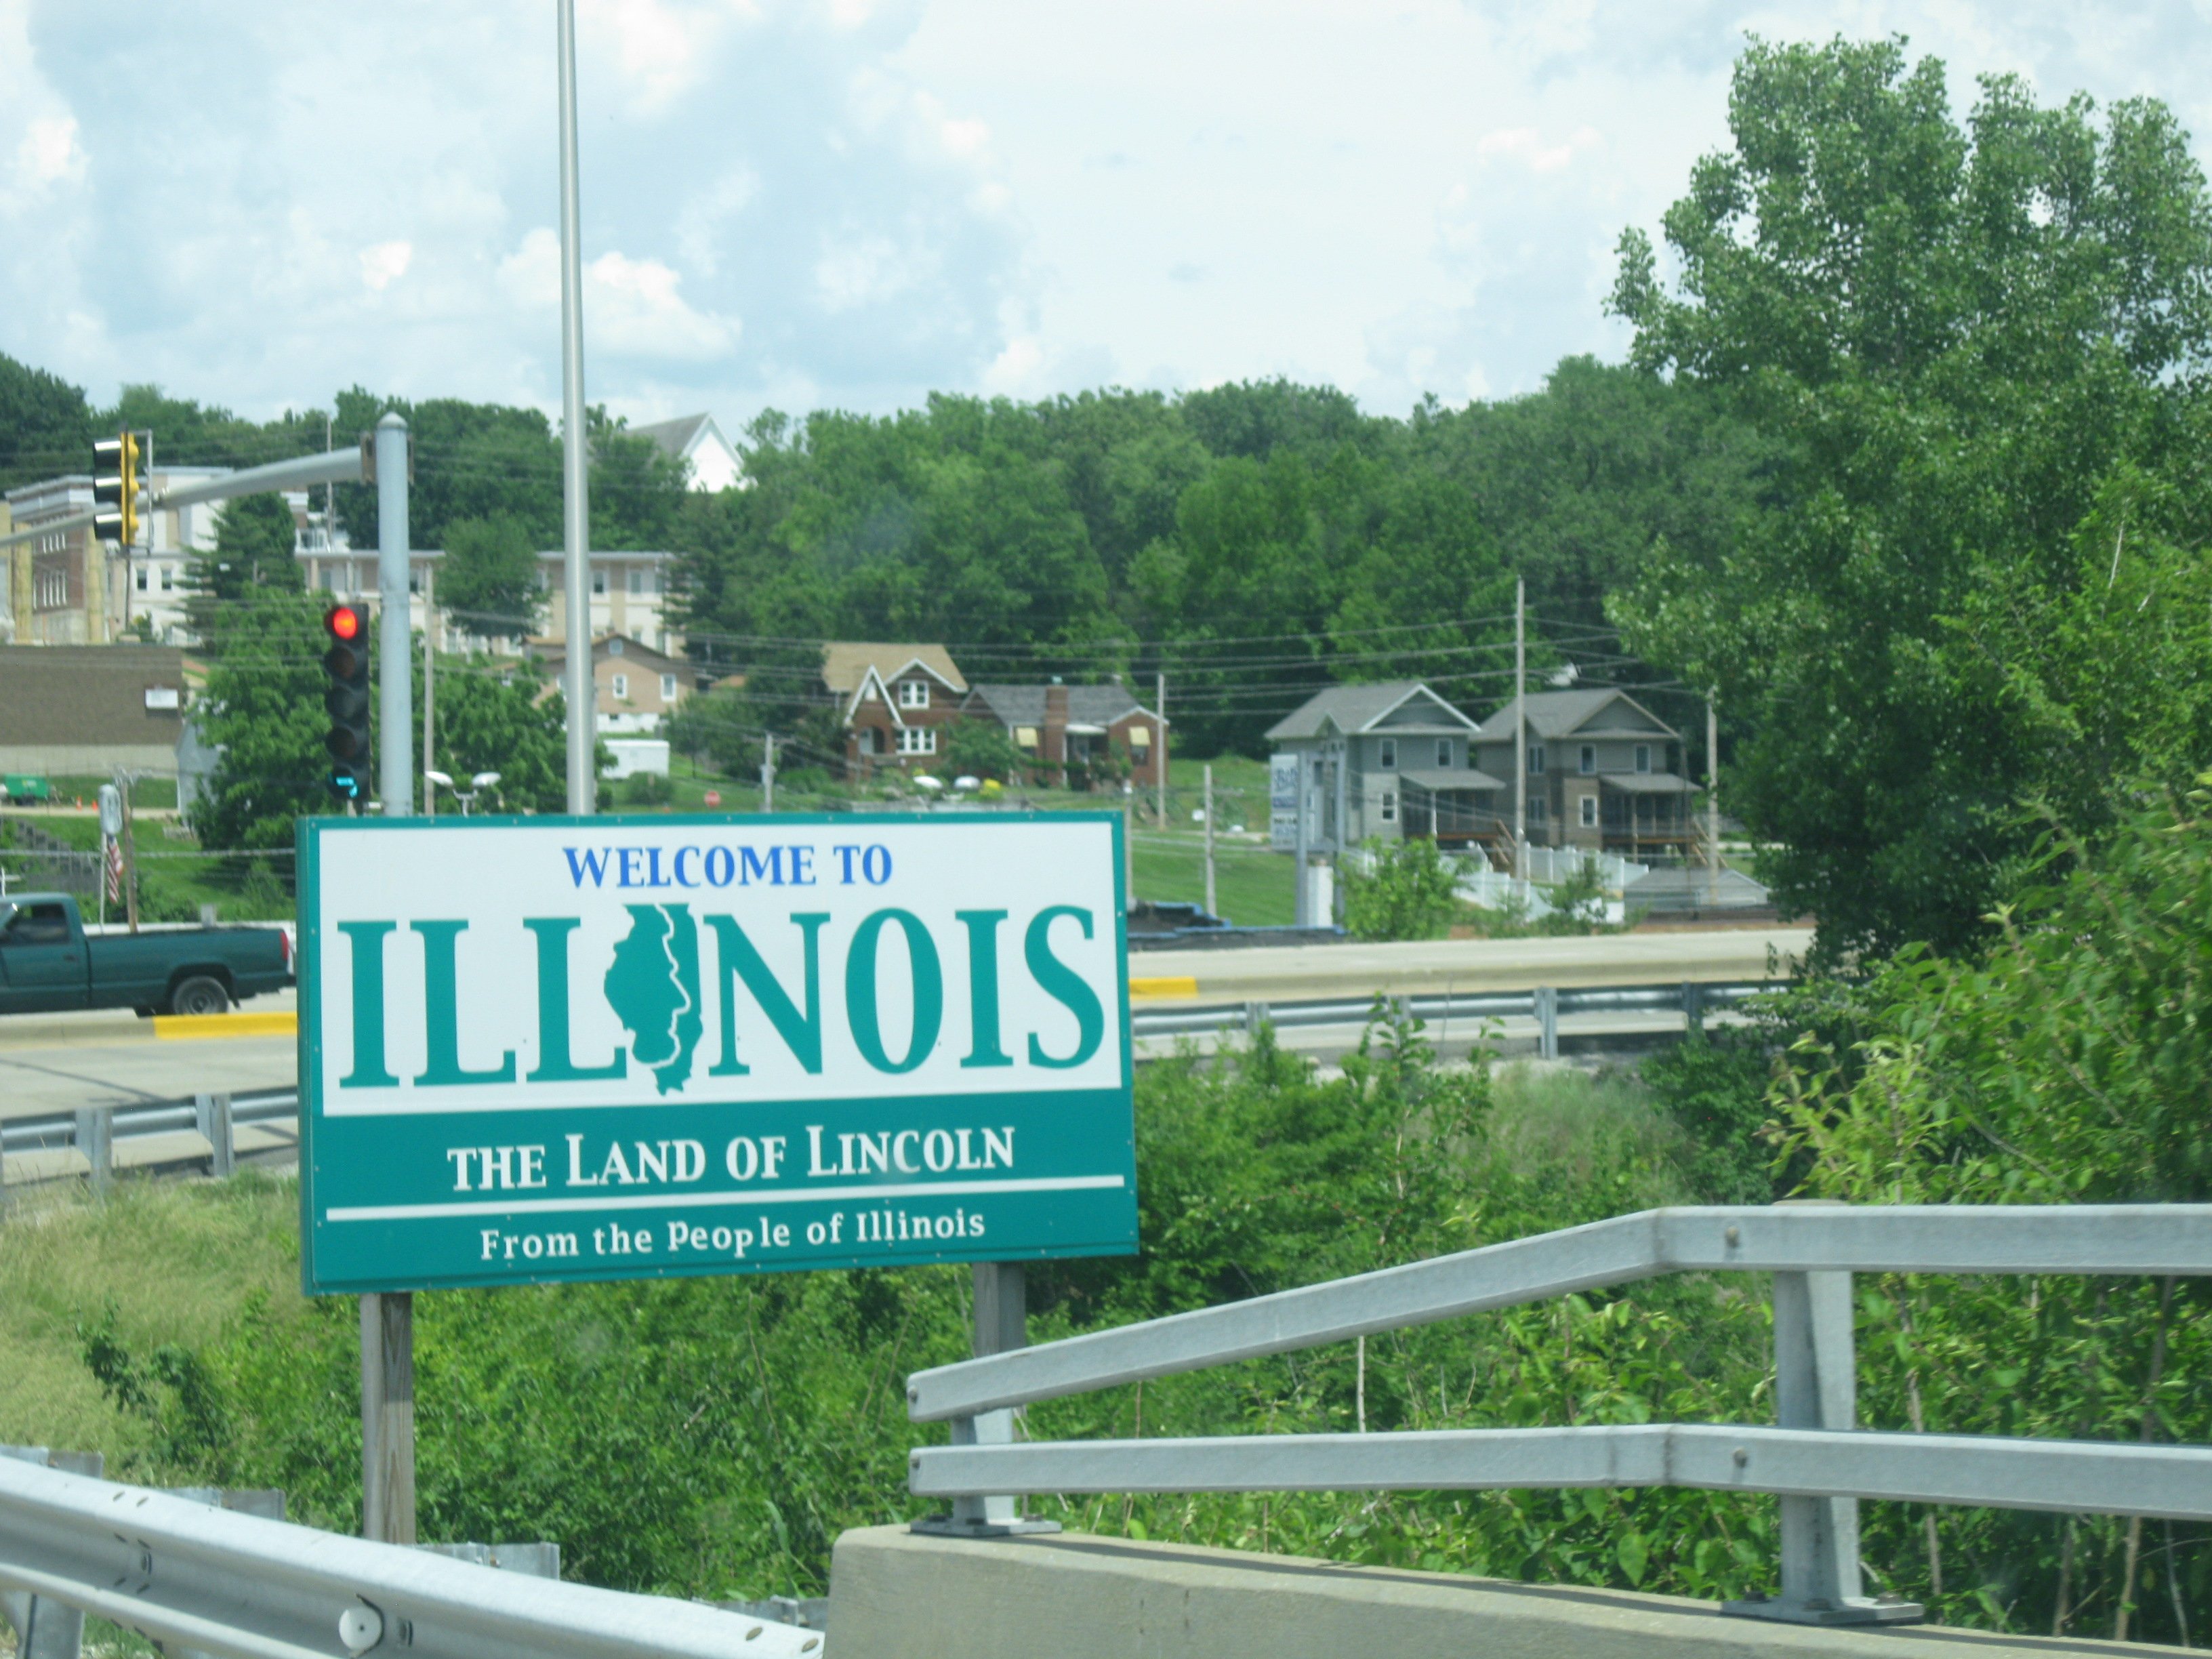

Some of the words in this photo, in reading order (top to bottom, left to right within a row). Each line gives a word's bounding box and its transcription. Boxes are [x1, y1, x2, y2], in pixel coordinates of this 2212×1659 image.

[563, 846, 816, 888] WELCOME
[833, 844, 893, 886] TO
[337, 903, 1105, 1097] ILLINOIS
[447, 1145, 547, 1191] THE
[566, 1134, 706, 1186] LAND
[726, 1136, 786, 1181] OF
[806, 1125, 1015, 1176] LINCOLN
[481, 1230, 579, 1260] From
[593, 1223, 652, 1254] the
[668, 1216, 790, 1258] People
[807, 1212, 844, 1245] of
[857, 1208, 985, 1242] Illinois
